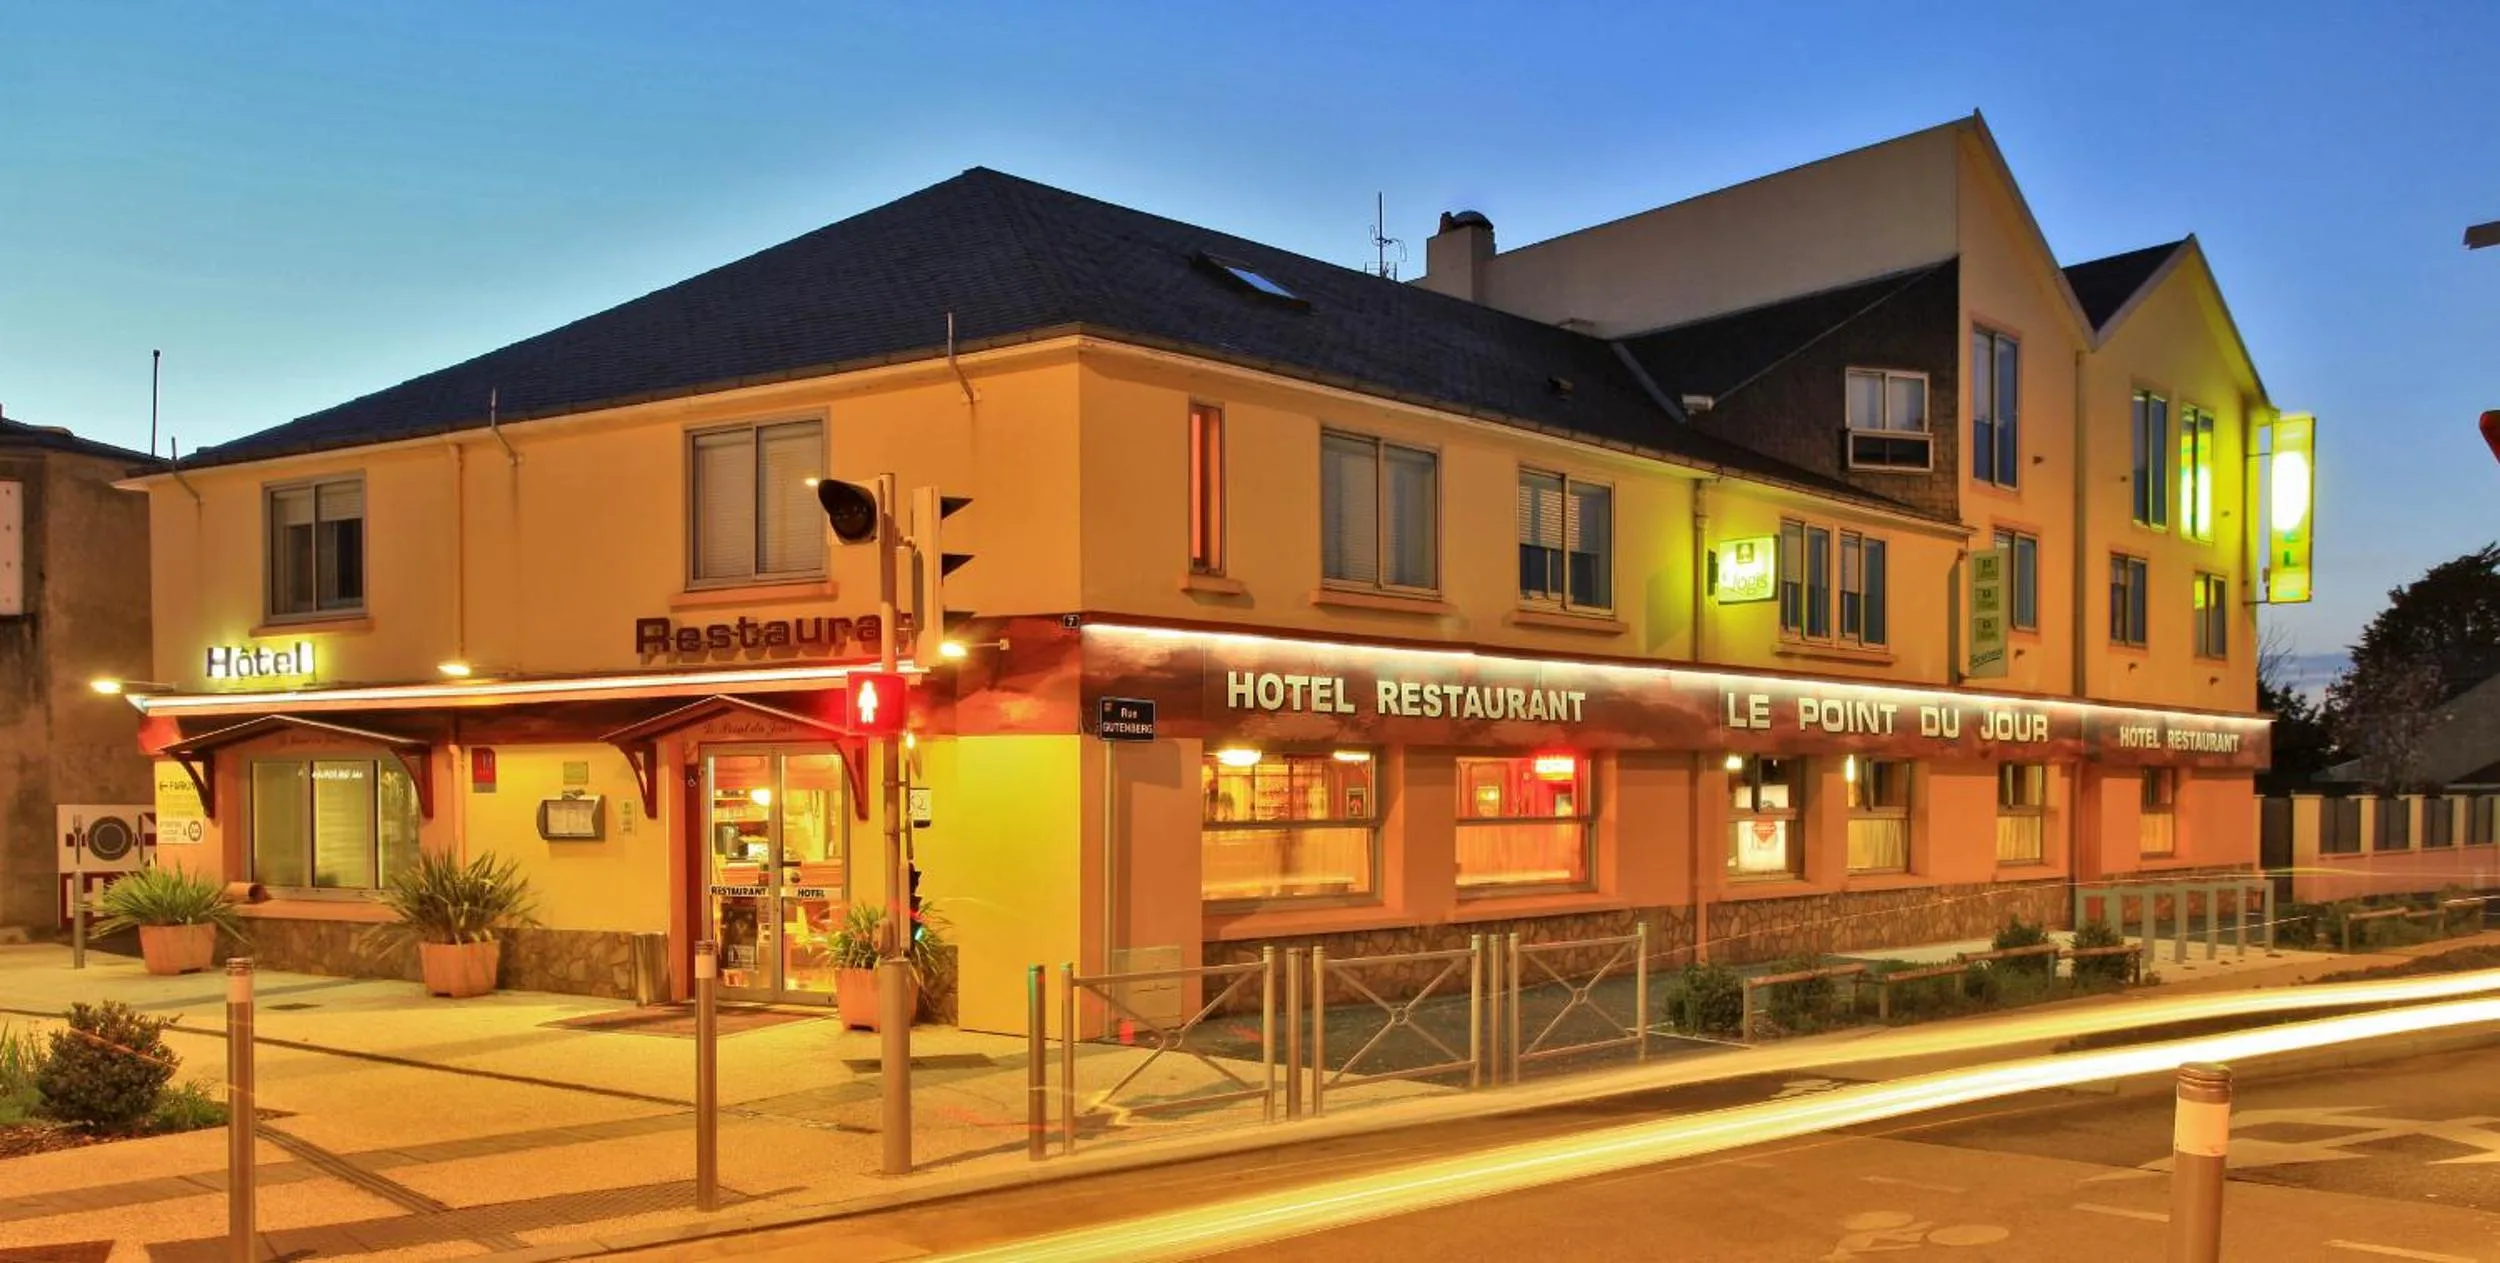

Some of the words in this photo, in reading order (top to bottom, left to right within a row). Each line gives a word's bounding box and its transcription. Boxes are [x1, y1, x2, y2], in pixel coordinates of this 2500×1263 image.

[1067, 616, 1075, 627] 7
[206, 641, 302, 678] Hôtel
[1227, 671, 1355, 714] HOTEL
[1376, 680, 1586, 722] RESTAURANT
[1120, 707, 1138, 719] Rue
[1727, 692, 1771, 729] LE
[1798, 697, 1898, 734] POINT
[1920, 706, 1960, 739] DU
[1980, 711, 2049, 742] JOUR
[1102, 721, 1154, 735] GUTENBERG
[2120, 726, 2160, 749] HOTEL
[2167, 729, 2240, 753] RESTAURANT
[711, 886, 767, 896] RESTAURANT
[798, 889, 825, 898] HOTEL
